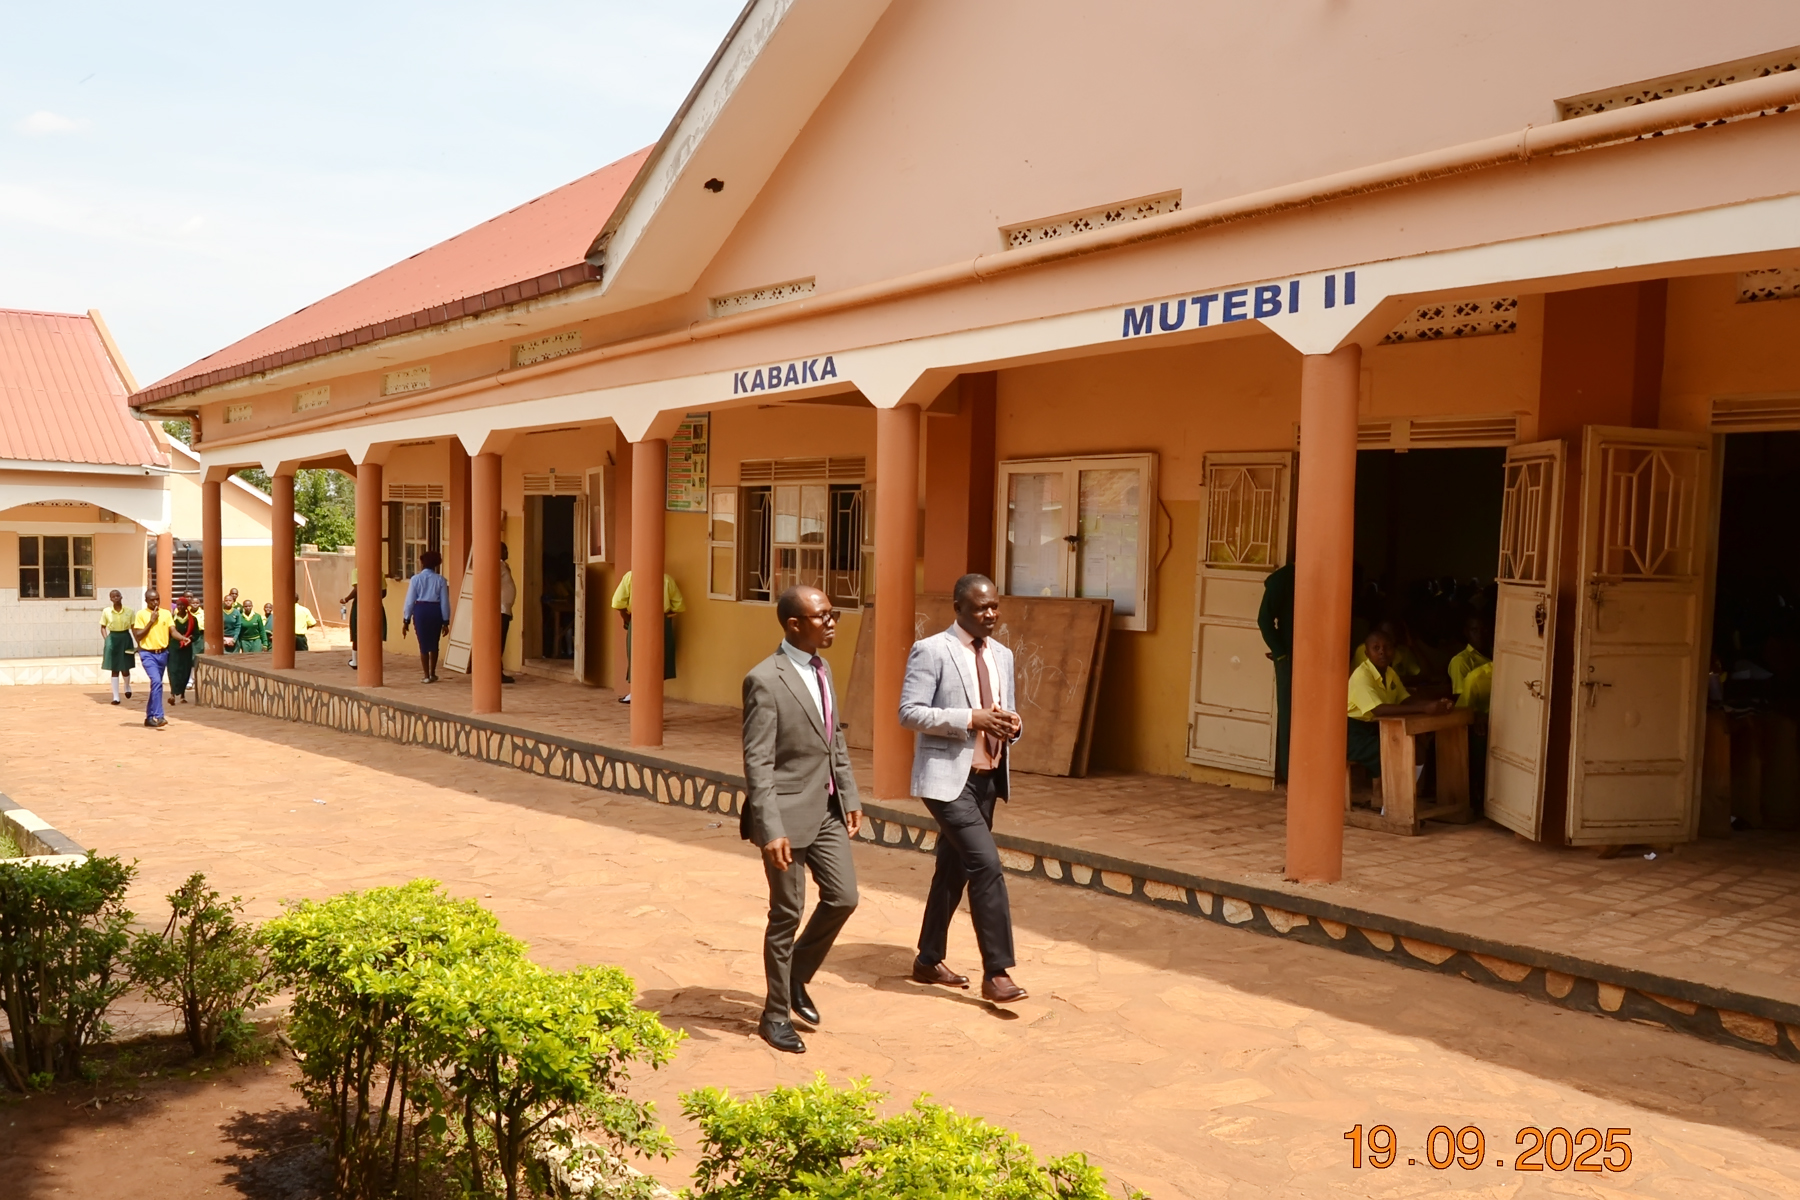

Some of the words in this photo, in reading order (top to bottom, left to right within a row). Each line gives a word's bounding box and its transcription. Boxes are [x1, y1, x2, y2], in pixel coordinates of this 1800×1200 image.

[733, 355, 838, 395] KABAKA
[1122, 279, 1301, 338] MUTEBI
[1324, 270, 1357, 310] II
